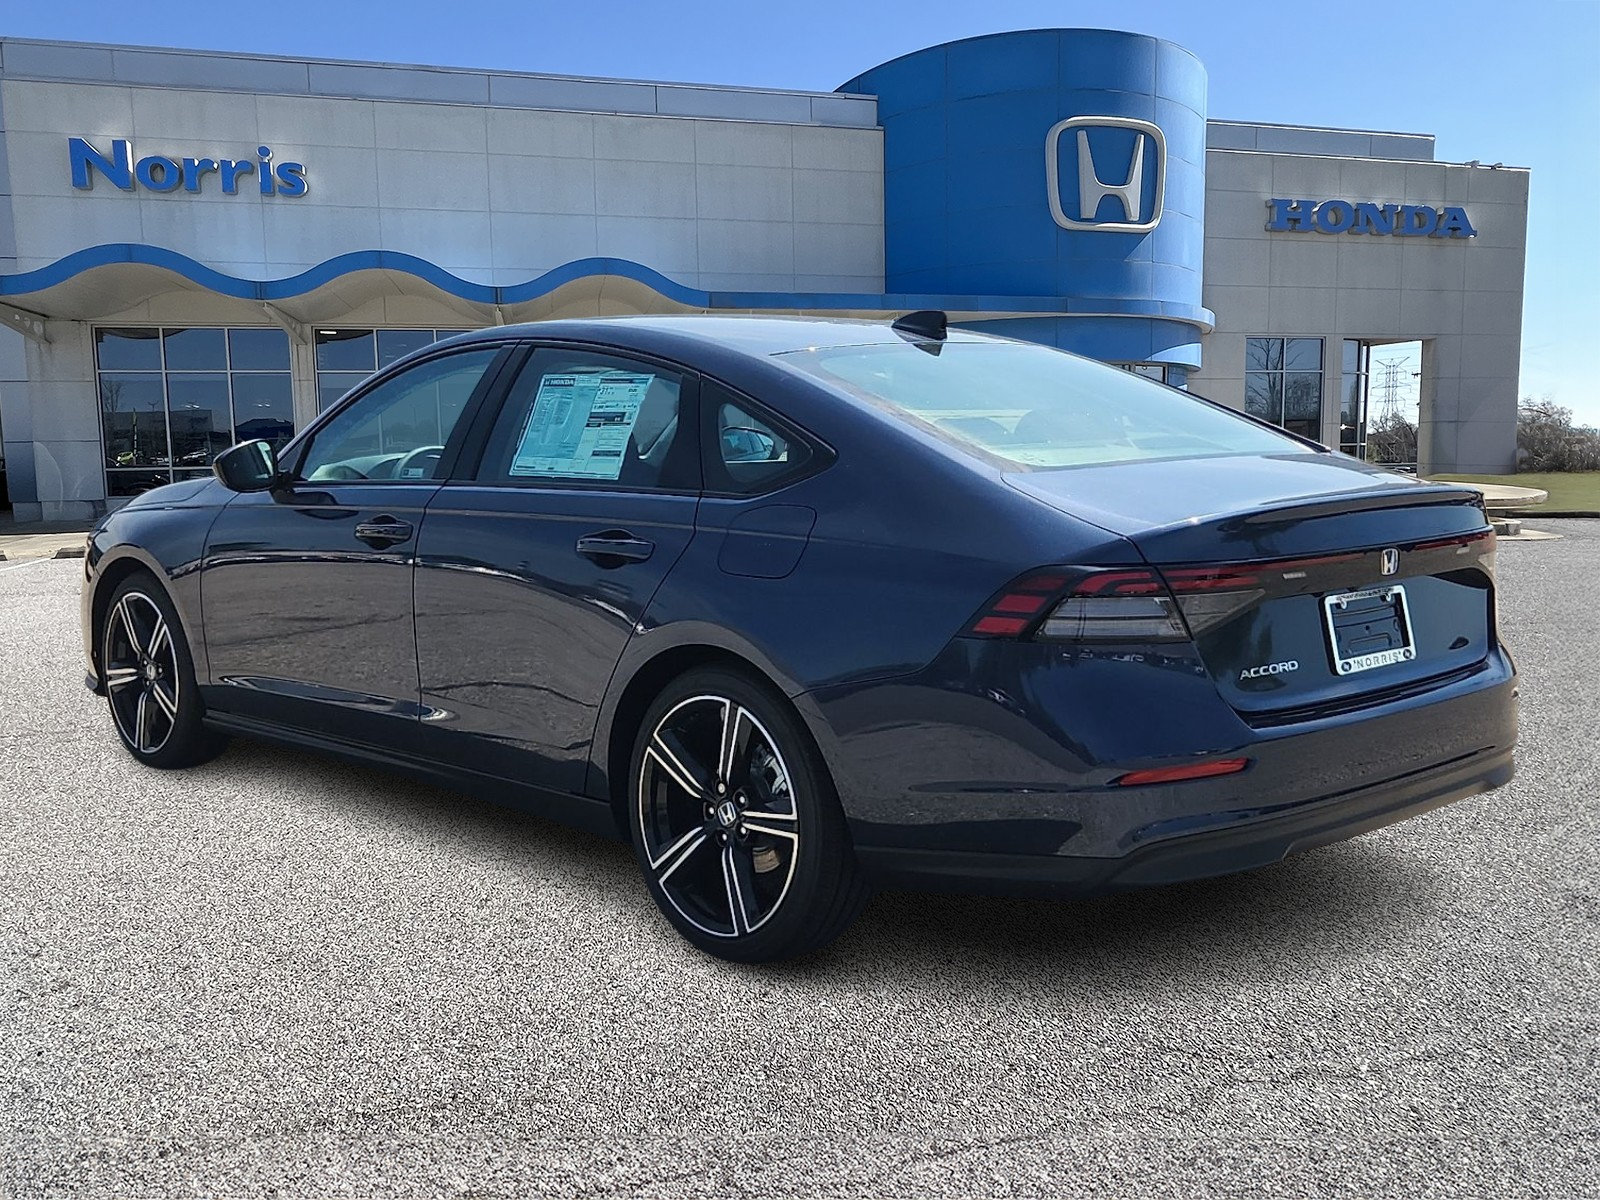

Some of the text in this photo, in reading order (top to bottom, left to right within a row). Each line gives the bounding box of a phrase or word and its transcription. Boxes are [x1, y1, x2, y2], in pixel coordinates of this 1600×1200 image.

[68, 137, 309, 197] Norris
[1266, 198, 1478, 239] HONDA
[550, 378, 575, 386] HONDA
[1239, 660, 1299, 681] ACCORD
